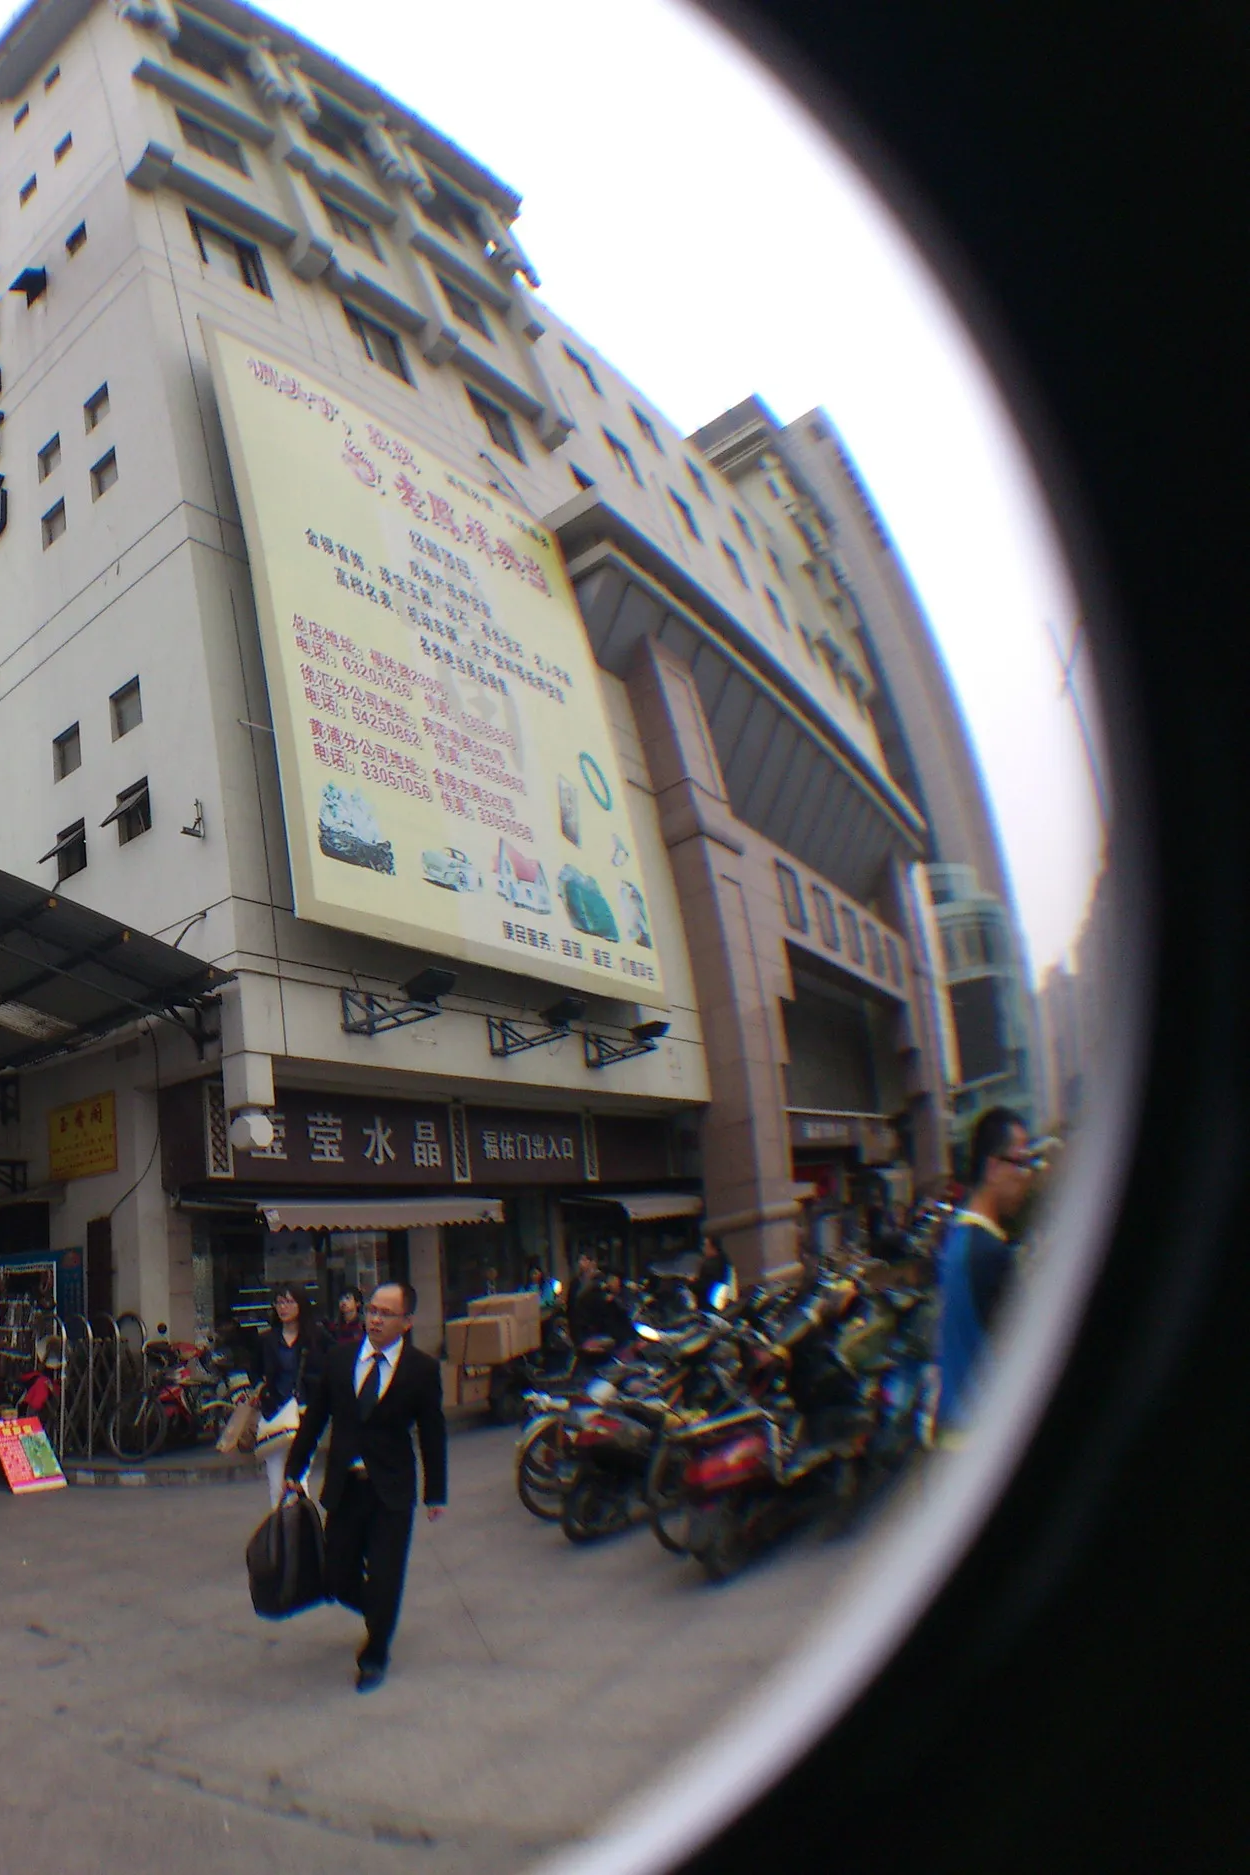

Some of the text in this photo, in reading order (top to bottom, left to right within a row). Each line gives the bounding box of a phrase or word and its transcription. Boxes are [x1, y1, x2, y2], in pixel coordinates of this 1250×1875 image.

[482, 1130, 574, 1160] 福佑门出入口
